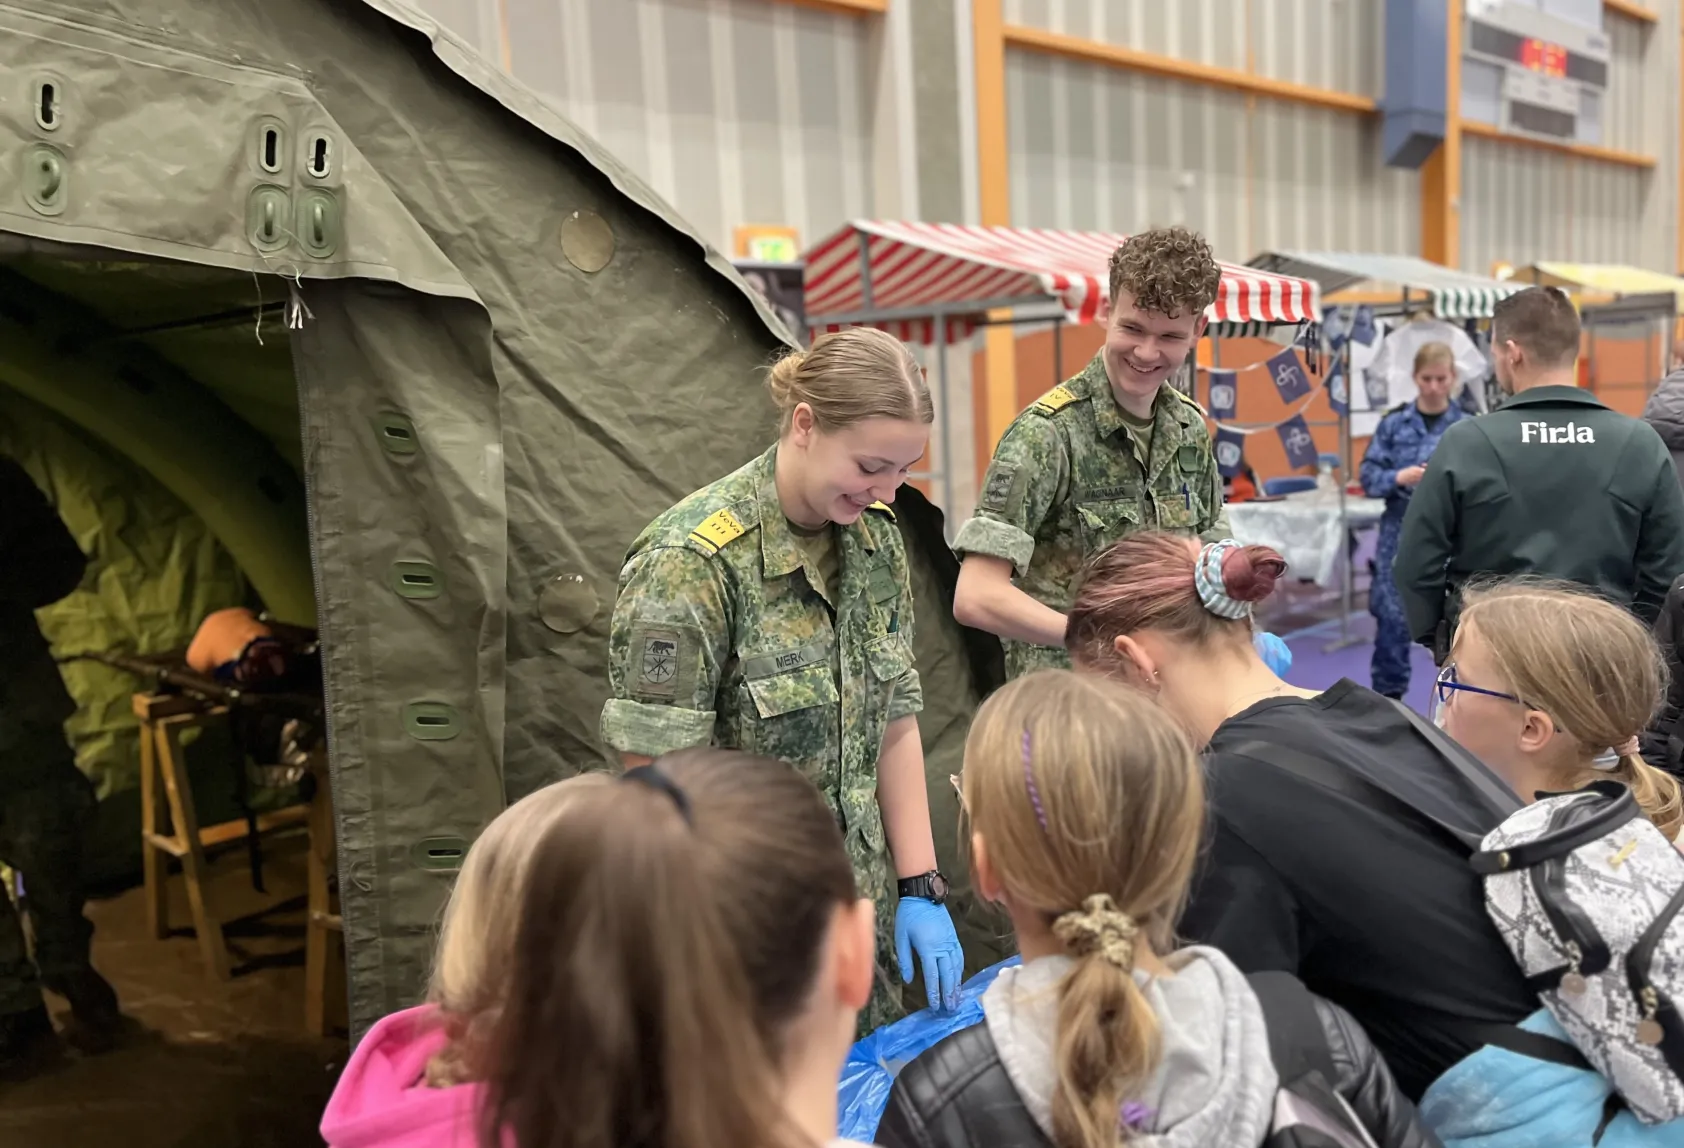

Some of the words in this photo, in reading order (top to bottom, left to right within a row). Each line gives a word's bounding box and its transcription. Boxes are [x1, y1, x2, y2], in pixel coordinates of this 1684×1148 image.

[1520, 421, 1596, 443] Firda
[710, 522, 727, 535] III
[719, 511, 741, 534] VeVa
[775, 650, 805, 669] MERK
